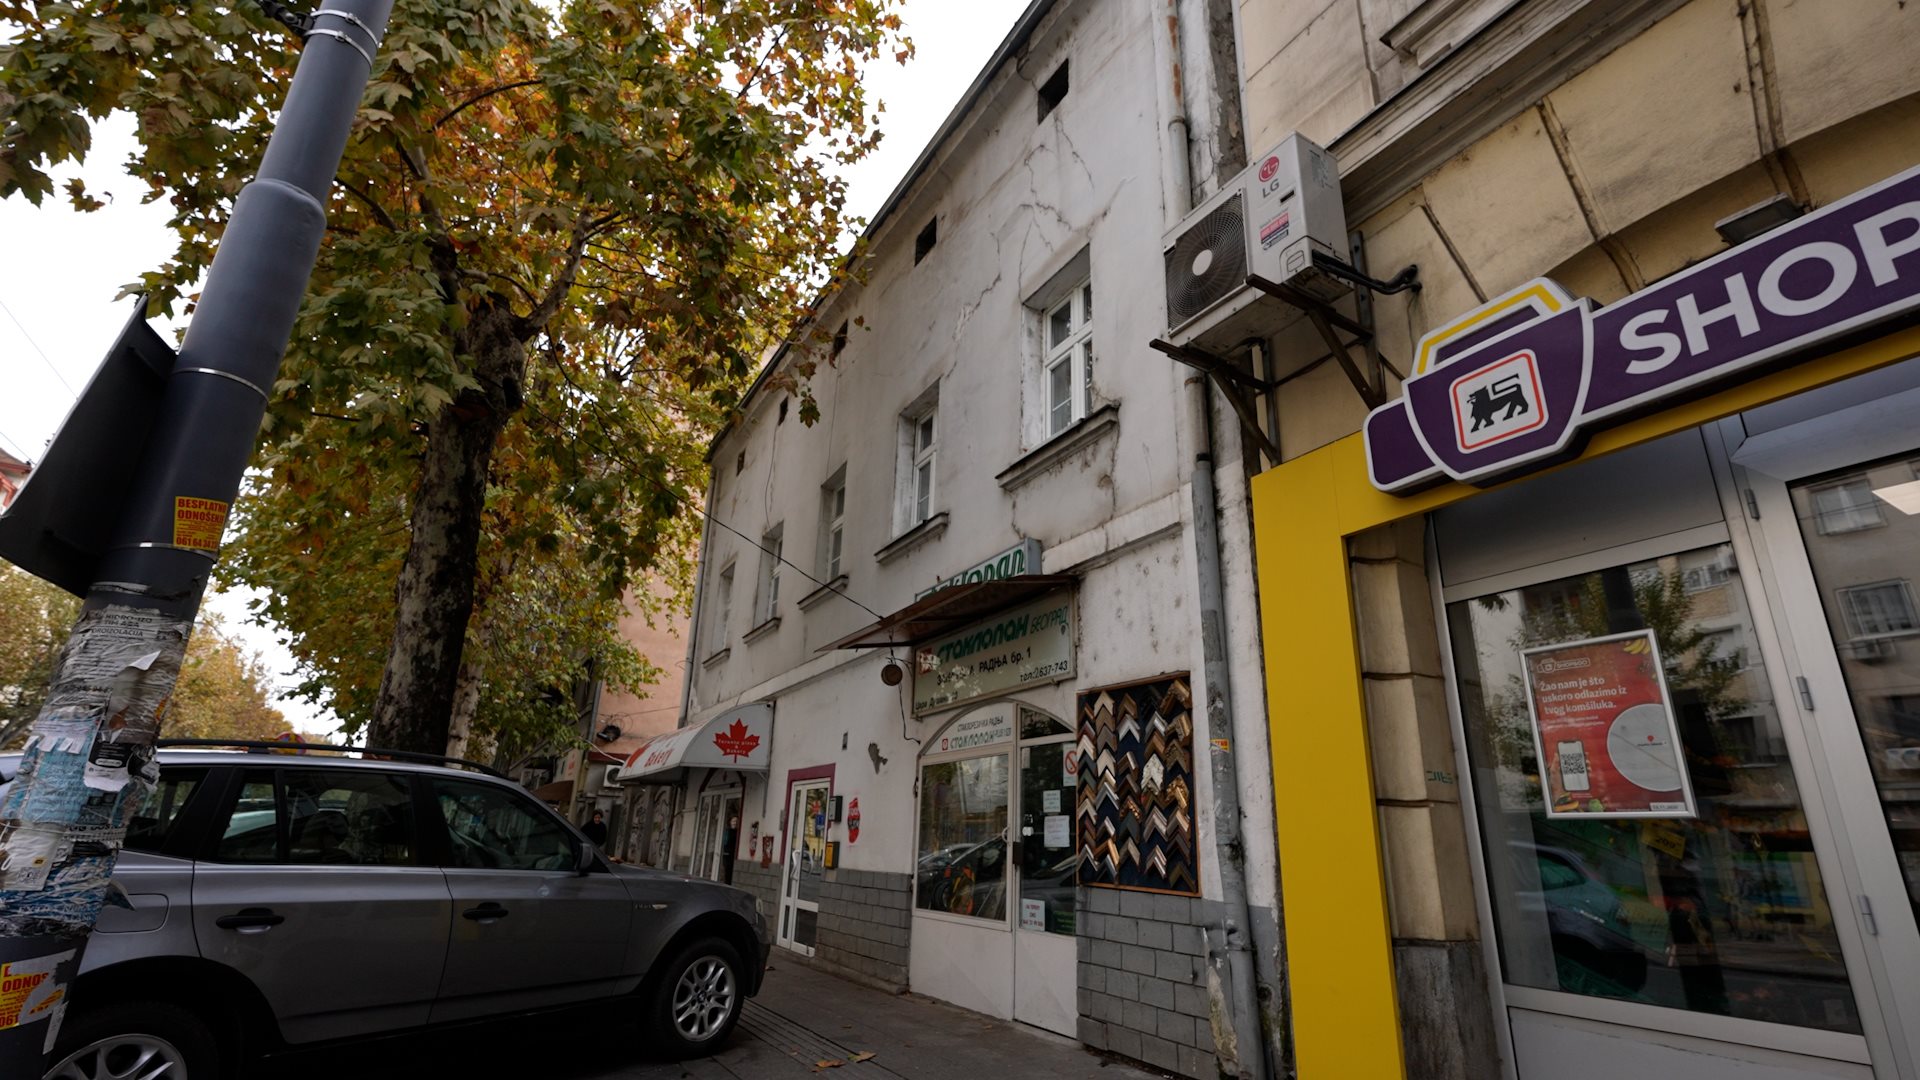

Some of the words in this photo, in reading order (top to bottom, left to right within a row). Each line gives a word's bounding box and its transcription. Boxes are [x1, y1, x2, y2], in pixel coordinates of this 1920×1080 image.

[1262, 178, 1280, 198] LG
[1619, 200, 1920, 375] SHOP
[979, 654, 1007, 672] РАДЊА
[1026, 647, 1031, 659] 1
[1557, 681, 1578, 690] nam
[1578, 678, 1588, 689] je
[1589, 676, 1605, 686] što
[1542, 693, 1573, 703] uskoro
[1574, 688, 1617, 699] odlazimo
[1618, 685, 1627, 695] iz
[1544, 705, 1566, 716] tvog
